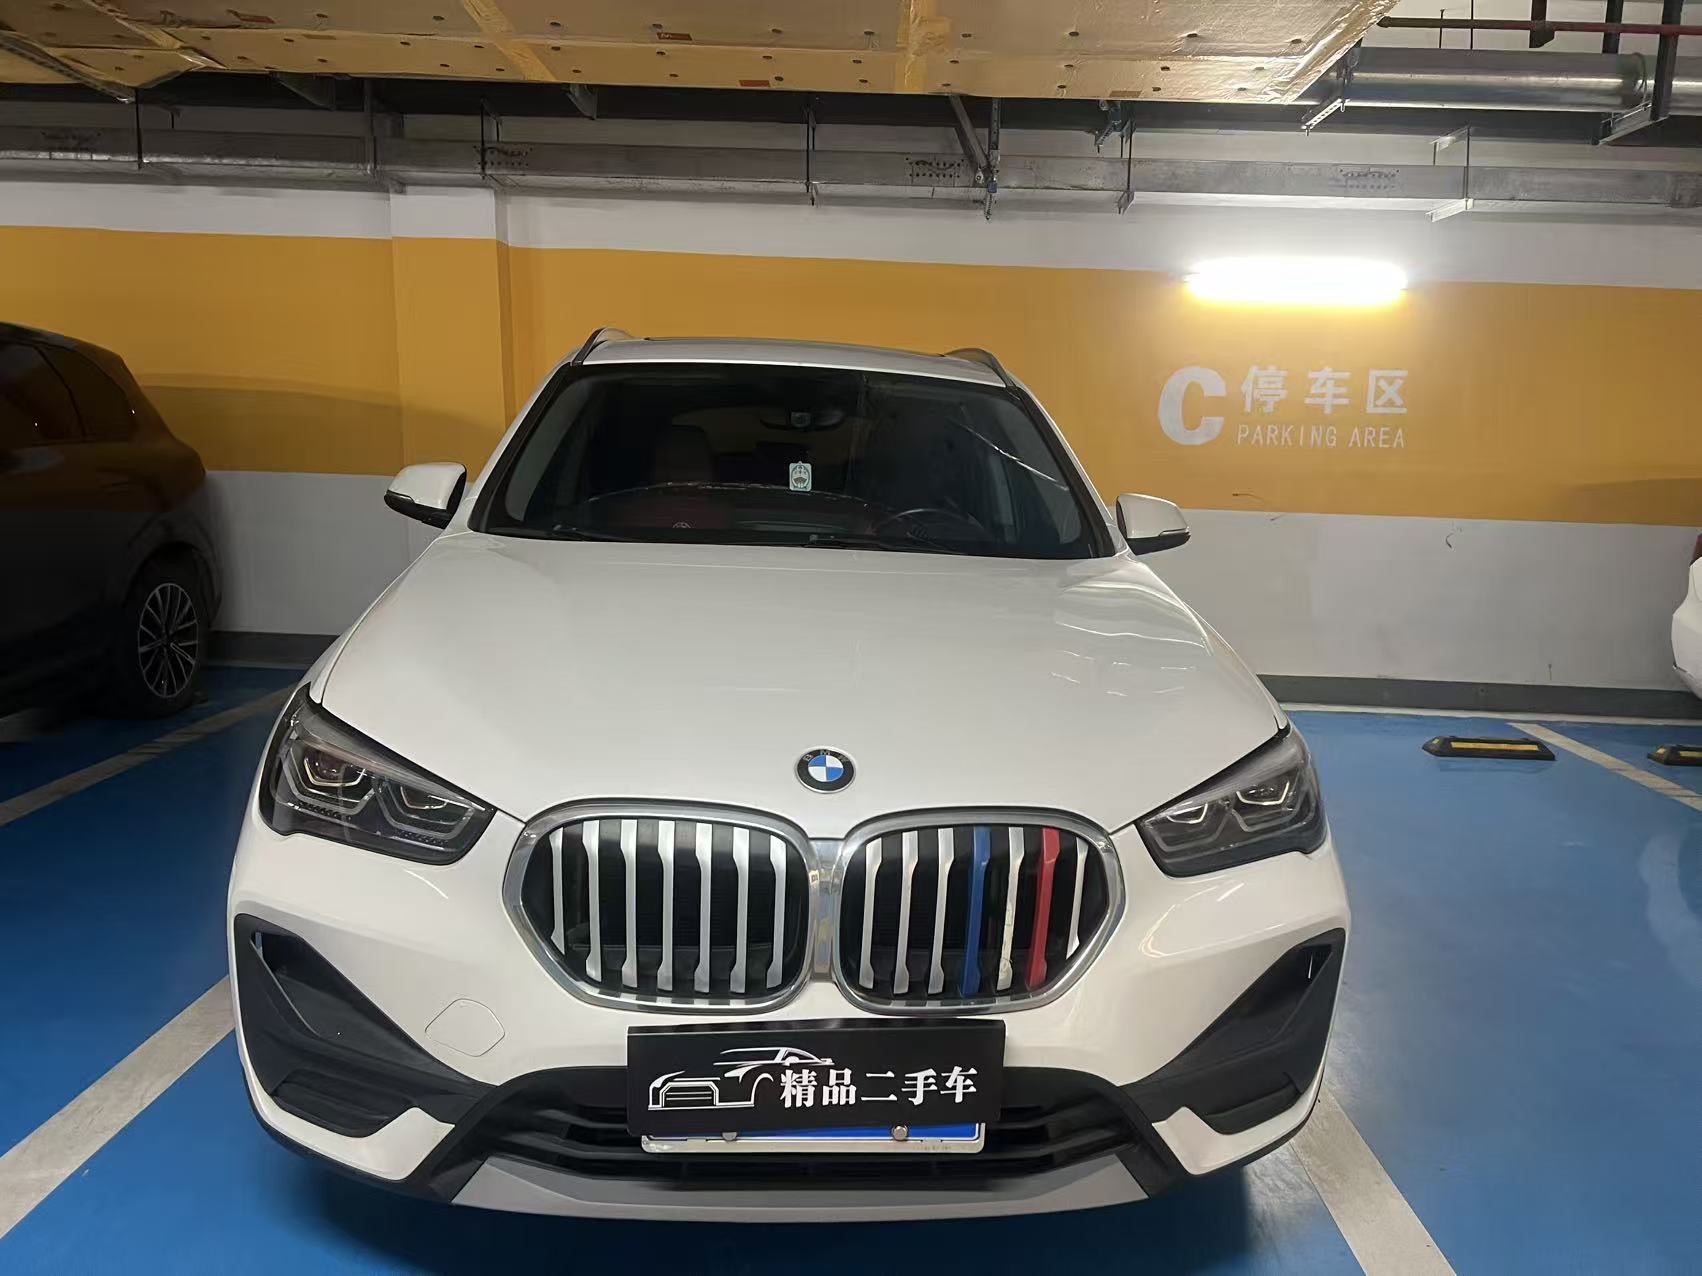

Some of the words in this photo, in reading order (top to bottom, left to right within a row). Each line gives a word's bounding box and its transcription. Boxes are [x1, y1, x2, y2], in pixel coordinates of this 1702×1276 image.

[1158, 366, 1227, 446] C
[1241, 365, 1409, 415] 停车区
[1237, 424, 1337, 447] PARKING
[1348, 427, 1405, 448] AREA
[779, 1065, 977, 1107] 精品二手车
